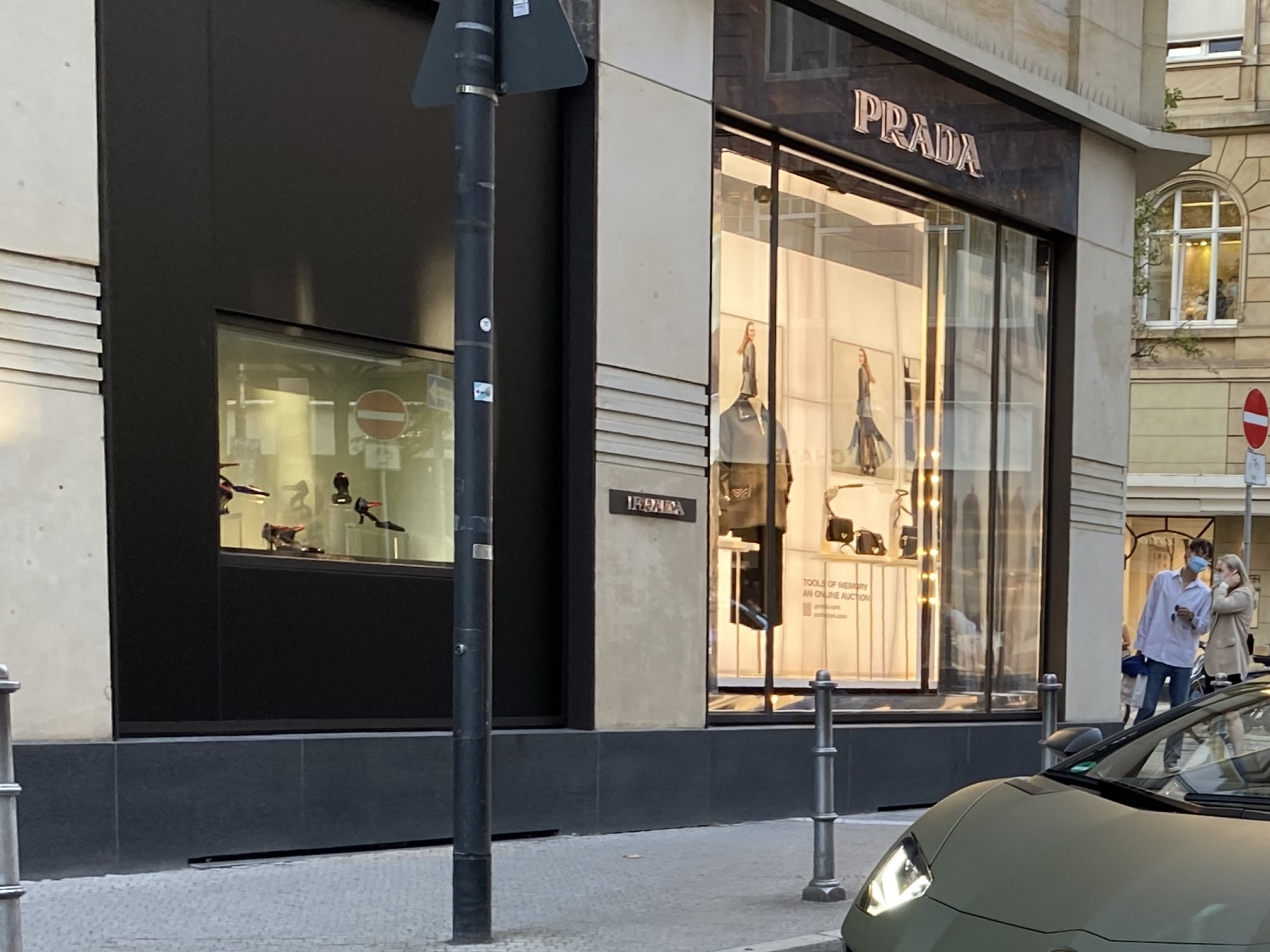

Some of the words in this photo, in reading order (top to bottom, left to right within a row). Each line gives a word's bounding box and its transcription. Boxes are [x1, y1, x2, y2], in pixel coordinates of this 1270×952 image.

[853, 88, 985, 179] PRADA
[627, 495, 685, 516] PRADA
[802, 578, 826, 587] TOOLS
[827, 580, 837, 588] OF
[838, 581, 868, 591] MEMORY
[802, 589, 813, 597] AN
[814, 590, 840, 600] ONLINE
